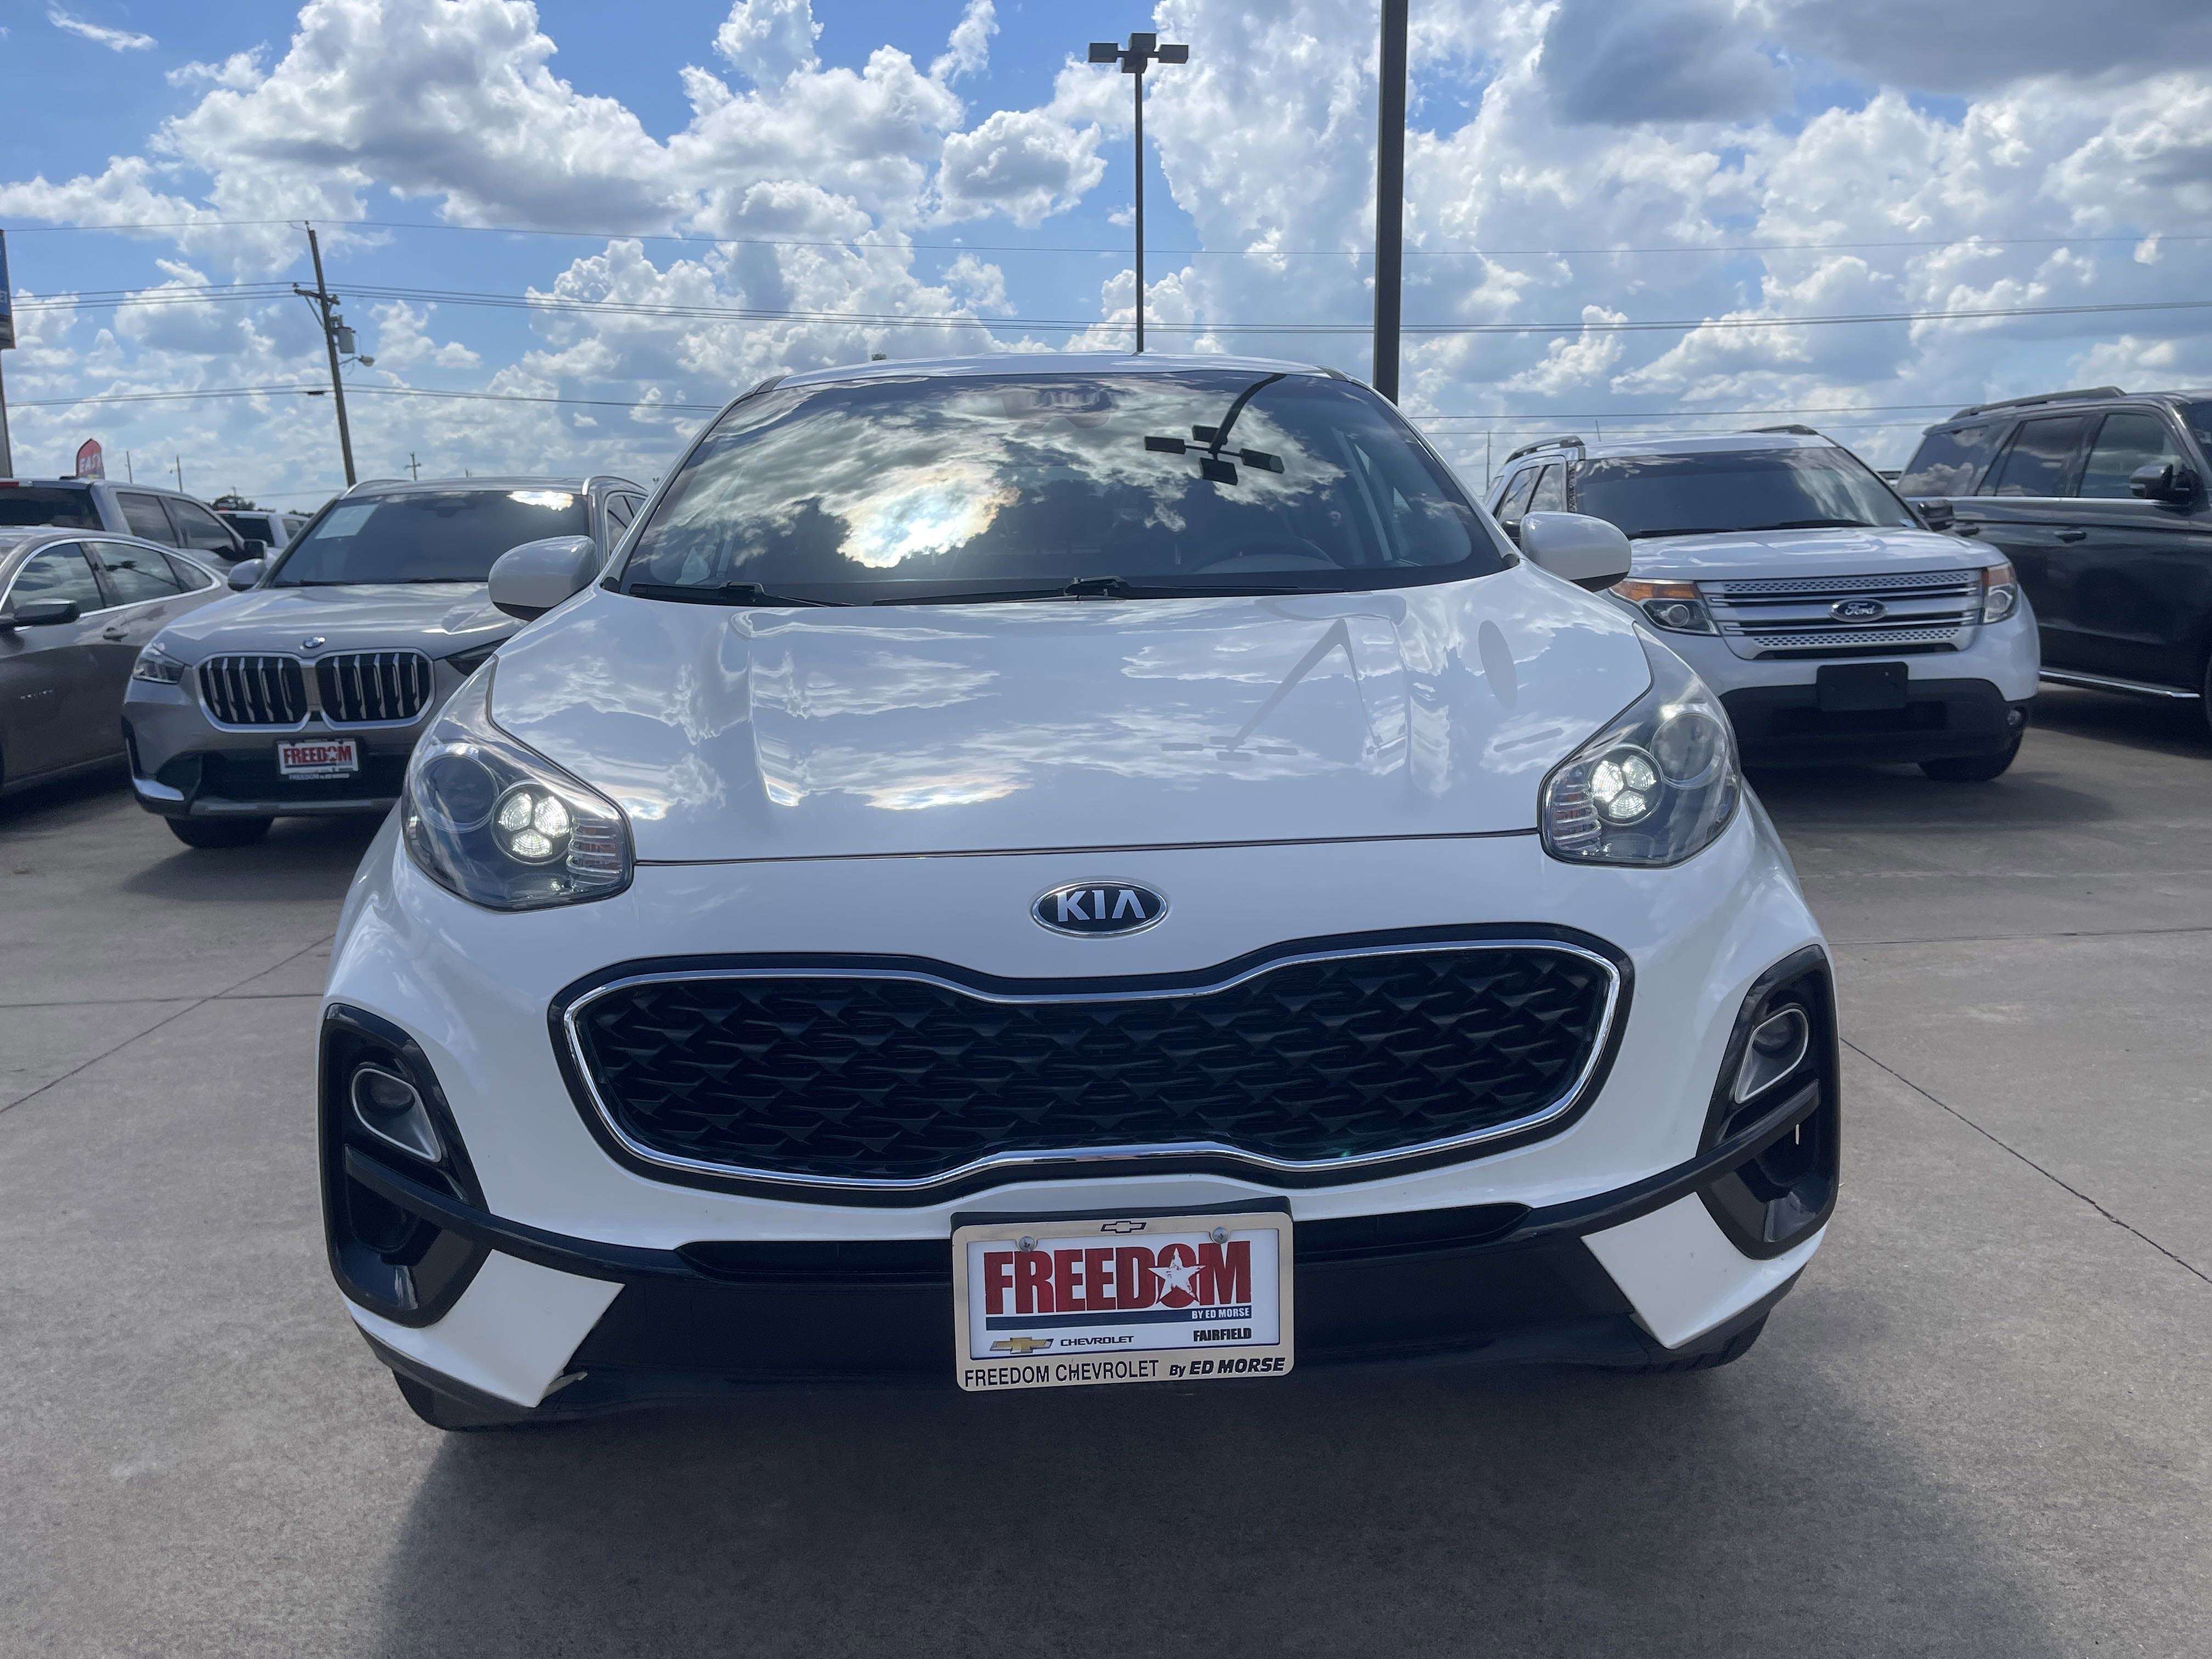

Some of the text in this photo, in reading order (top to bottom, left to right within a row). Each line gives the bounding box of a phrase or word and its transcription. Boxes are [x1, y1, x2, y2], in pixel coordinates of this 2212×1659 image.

[1844, 602, 1876, 616] Ford
[283, 746, 352, 764] FREEDOM
[1056, 889, 1146, 922] KIA
[984, 1240, 1251, 1314] FREEDOM
[1191, 1307, 1250, 1319] BY ED MORSE
[1060, 1335, 1134, 1347] CHEVROLET
[1193, 1328, 1252, 1342] FAIRFIELD
[964, 1357, 1286, 1387] FREEDOM CHEVROLET By ED MORSE
